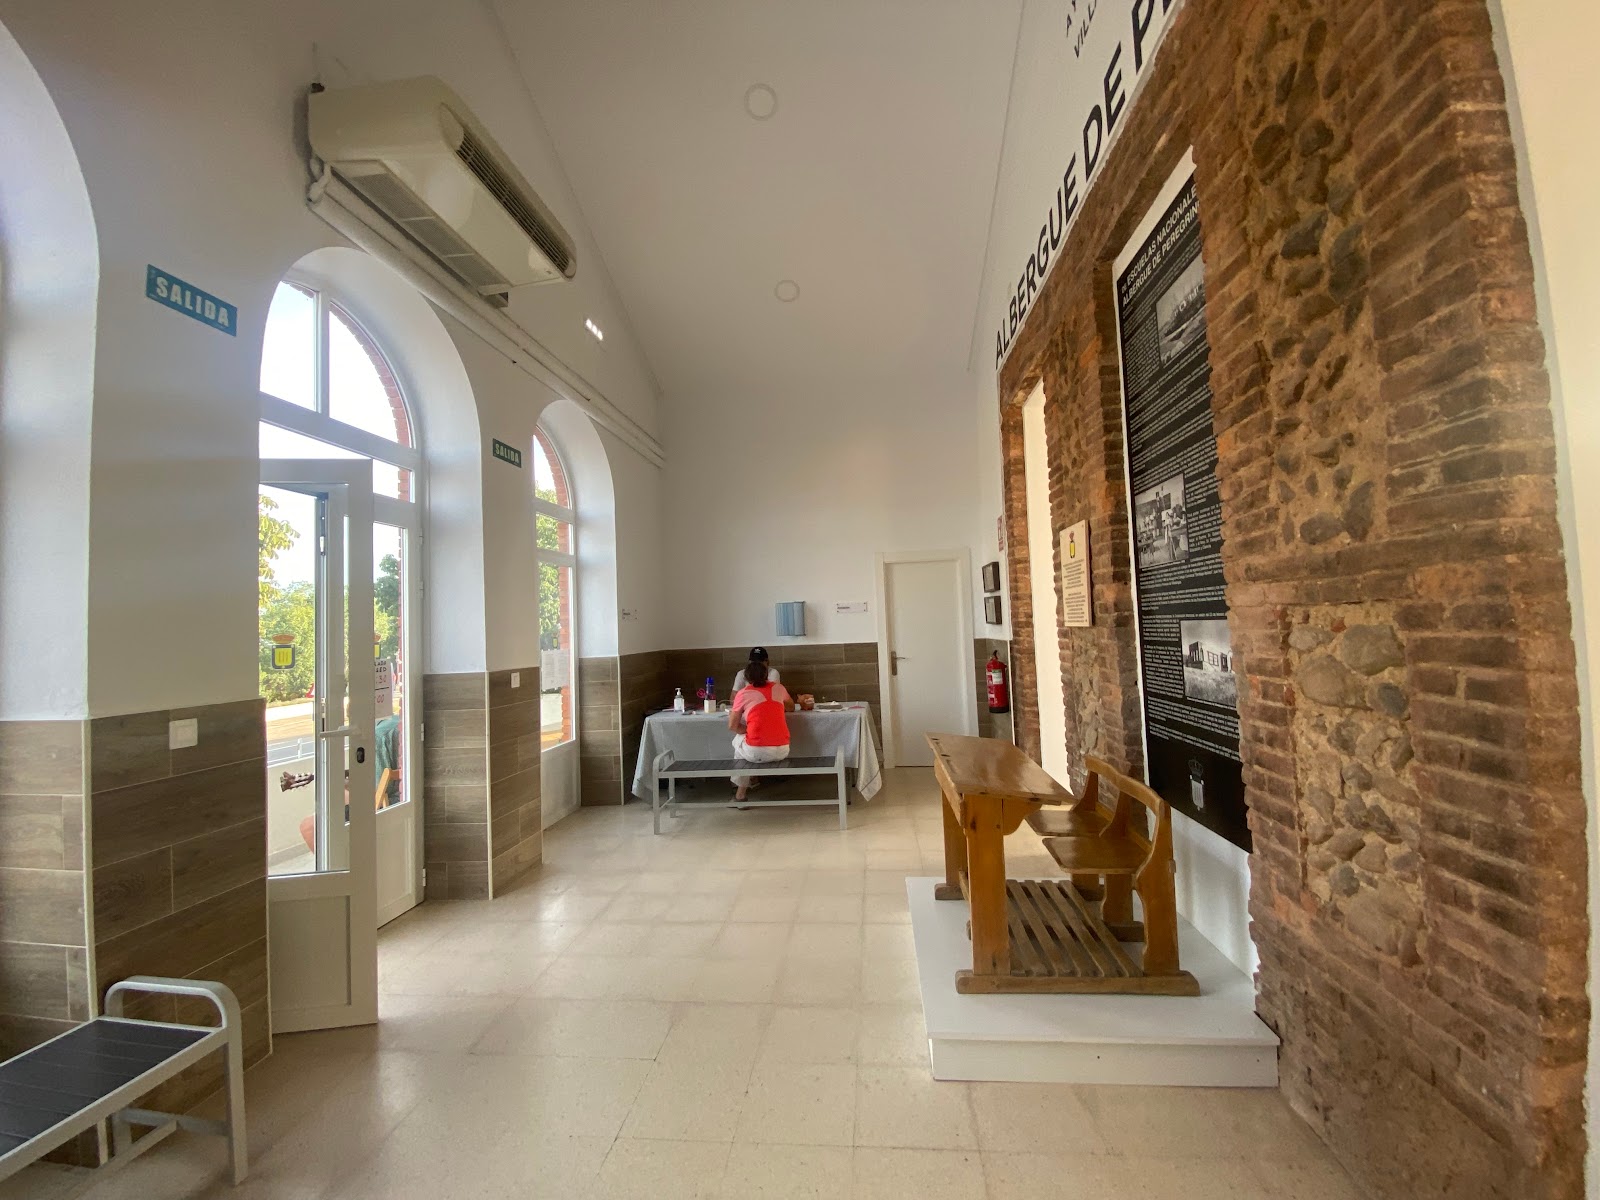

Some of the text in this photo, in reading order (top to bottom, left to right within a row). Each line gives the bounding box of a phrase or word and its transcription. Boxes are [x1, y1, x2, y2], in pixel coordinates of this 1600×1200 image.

[1074, 0, 1097, 58] VILL
[996, 0, 1173, 370] ALBERGUE DE P
[1123, 263, 1152, 307] ALBERGUE
[1152, 250, 1161, 269] DE
[1127, 240, 1157, 286] ESCUELAS
[156, 276, 229, 327] SALIDA
[495, 443, 520, 464] SALIDA
